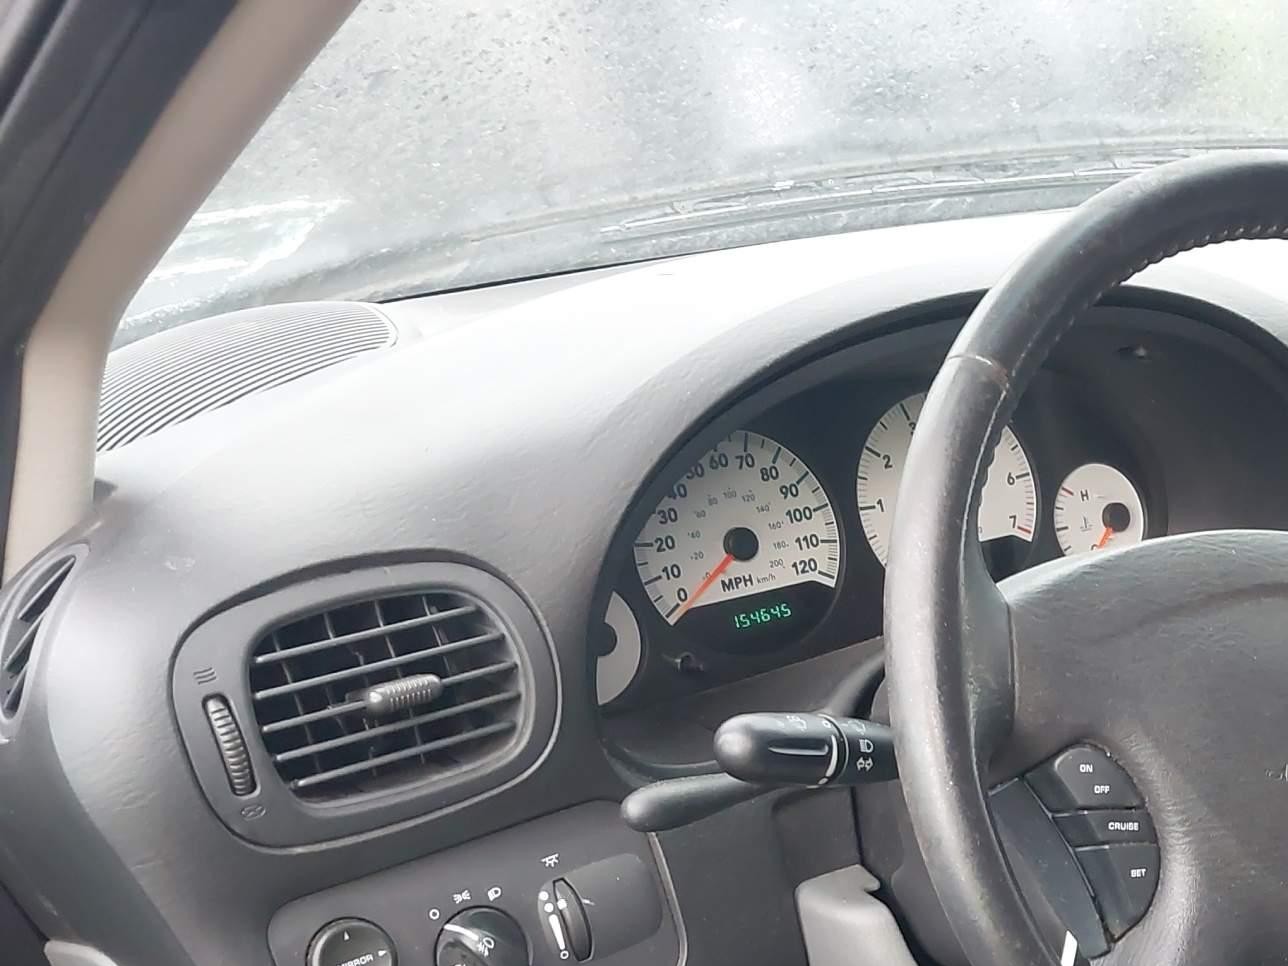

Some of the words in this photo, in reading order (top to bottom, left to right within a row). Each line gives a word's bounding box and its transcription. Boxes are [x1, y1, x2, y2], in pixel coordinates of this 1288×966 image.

[709, 453, 729, 470] 60
[735, 454, 755, 470] 70
[882, 455, 893, 469] 2
[760, 466, 779, 482] 80
[1006, 471, 1016, 486] 6
[780, 483, 799, 499] 90
[1080, 489, 1089, 501] H
[876, 498, 885, 513] 1
[657, 507, 678, 524] 30
[786, 506, 813, 524] 100
[1009, 515, 1017, 529] 7
[654, 535, 676, 553] 20
[795, 534, 820, 551] 110
[769, 558, 784, 568] 200
[791, 558, 818, 576] 120
[662, 564, 682, 581] 10
[721, 574, 754, 593] MPH
[757, 573, 776, 584] km/h
[676, 588, 688, 602] 0
[734, 603, 792, 628] 154645
[1079, 764, 1093, 773] ON
[1094, 785, 1110, 794] OFF
[1108, 822, 1139, 831] CRUISE
[1130, 868, 1146, 877] SET
